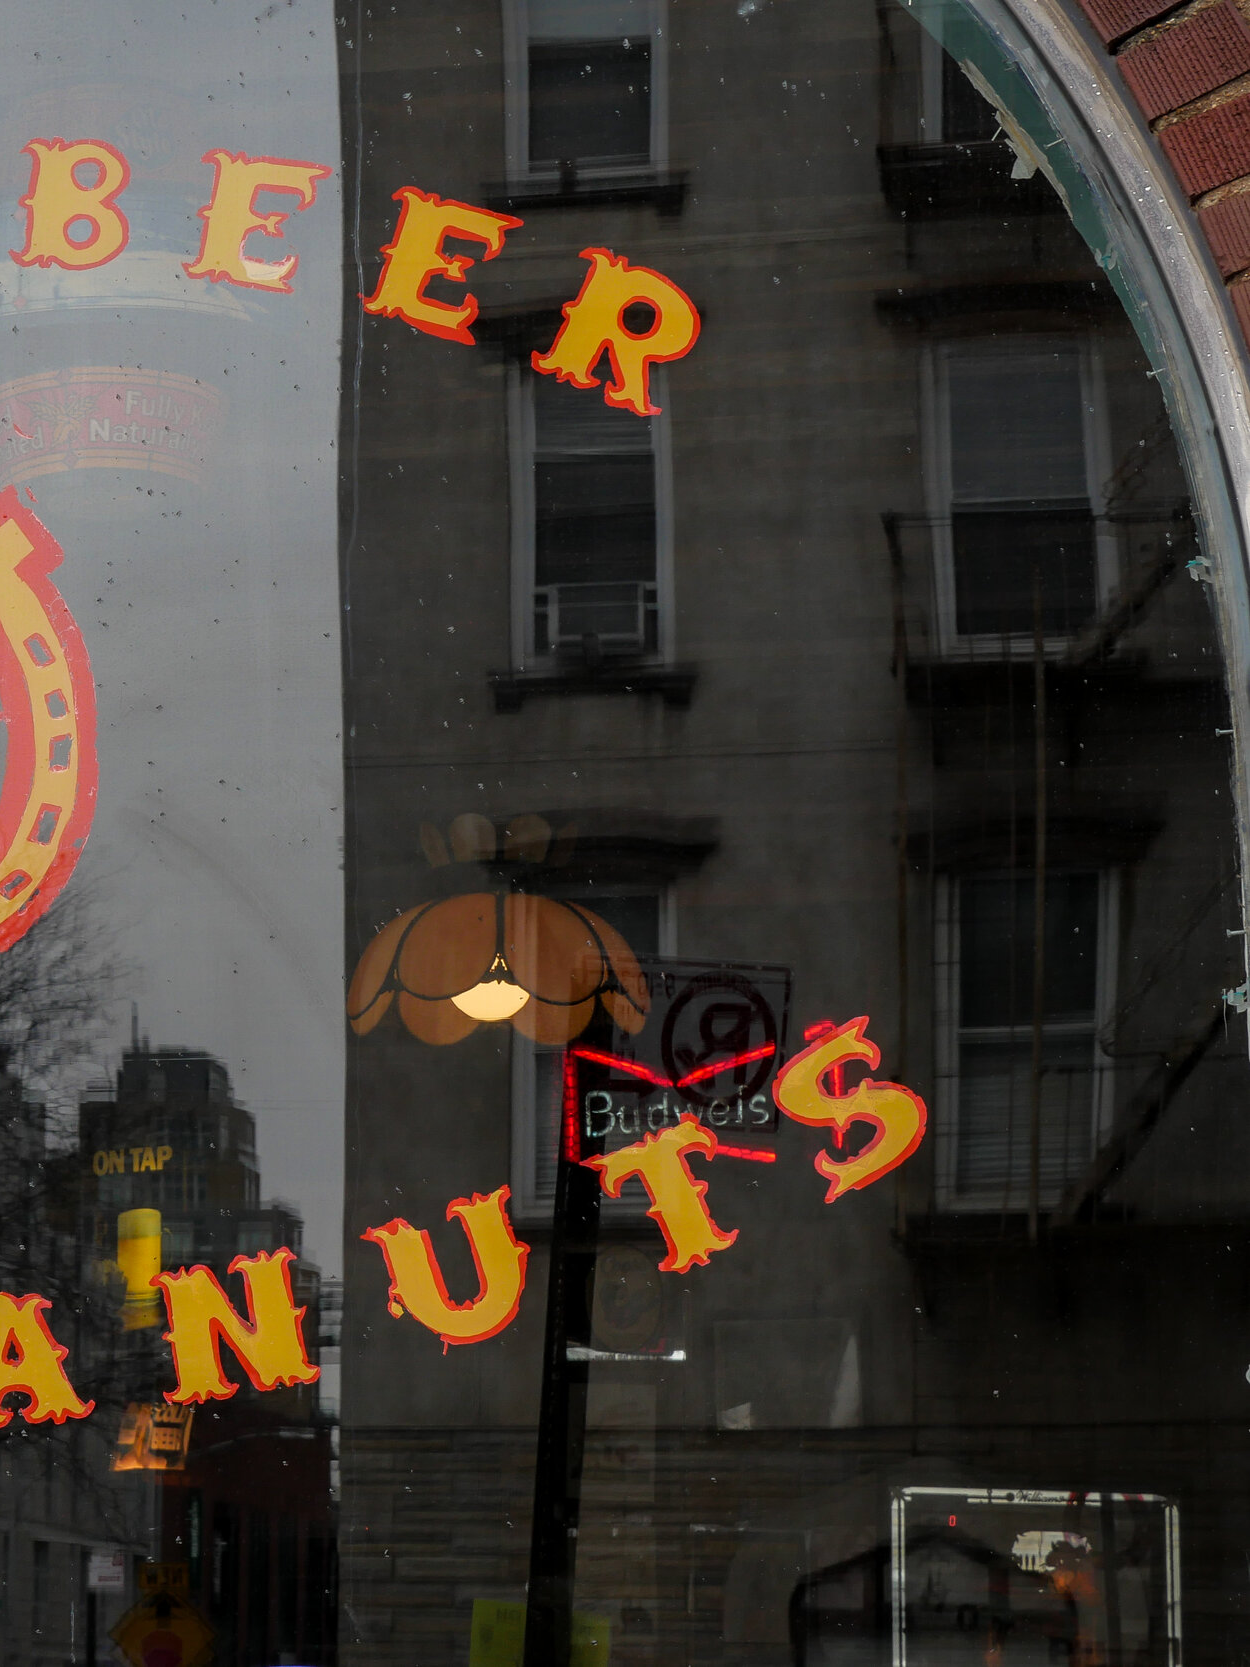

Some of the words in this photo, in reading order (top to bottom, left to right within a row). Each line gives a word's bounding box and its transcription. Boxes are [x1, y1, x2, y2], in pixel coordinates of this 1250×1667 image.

[8, 137, 701, 418] BEER
[584, 1085, 771, 1139] Budweis
[93, 1148, 125, 1176] ON
[130, 1145, 173, 1172] TAP
